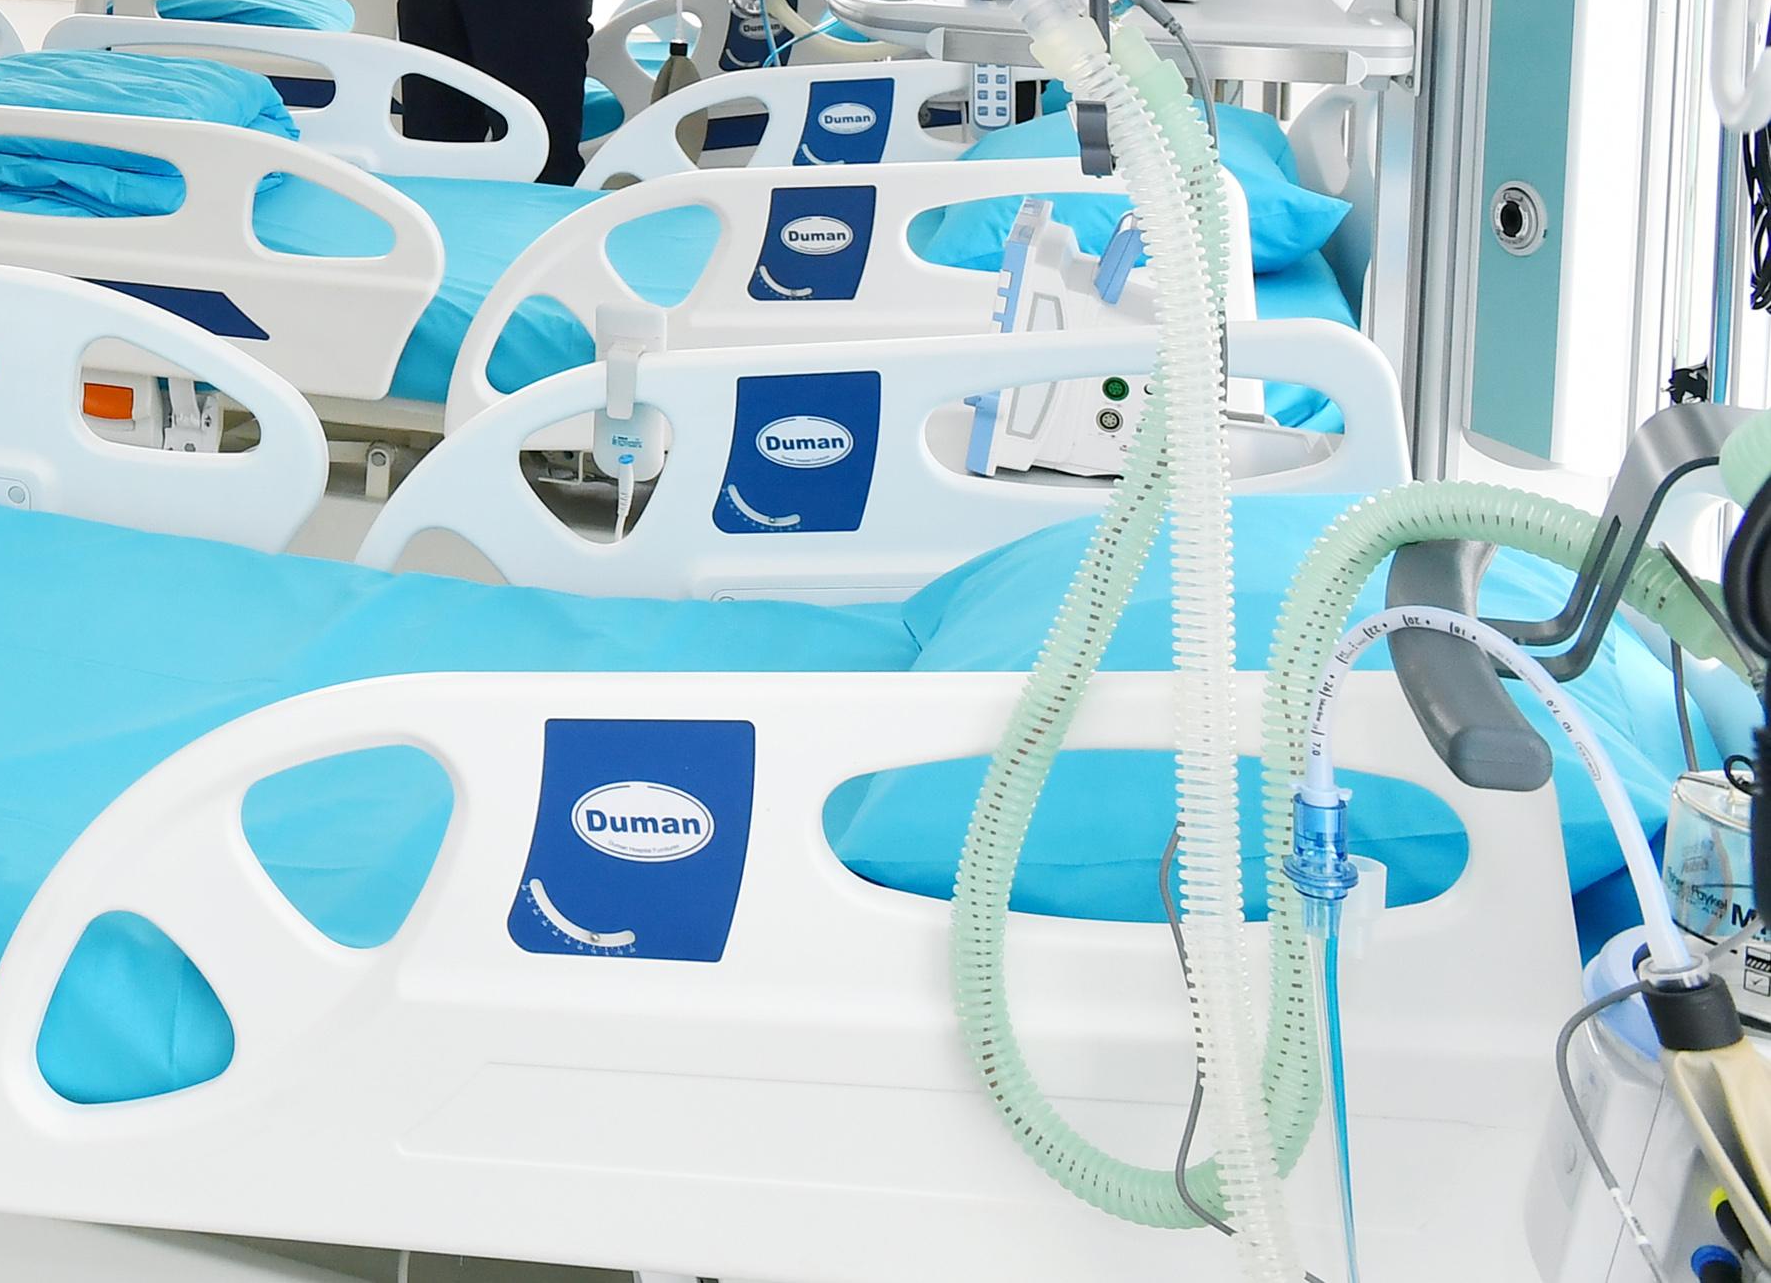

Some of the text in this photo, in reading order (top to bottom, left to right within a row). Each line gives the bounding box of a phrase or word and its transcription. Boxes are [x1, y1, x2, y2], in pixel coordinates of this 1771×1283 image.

[824, 113, 871, 125] Duman
[788, 230, 847, 242] Duman
[765, 435, 845, 451] Duman
[1546, 700, 1561, 715] 7.0
[1311, 742, 1322, 757] 7.0
[585, 809, 701, 835] Duman
